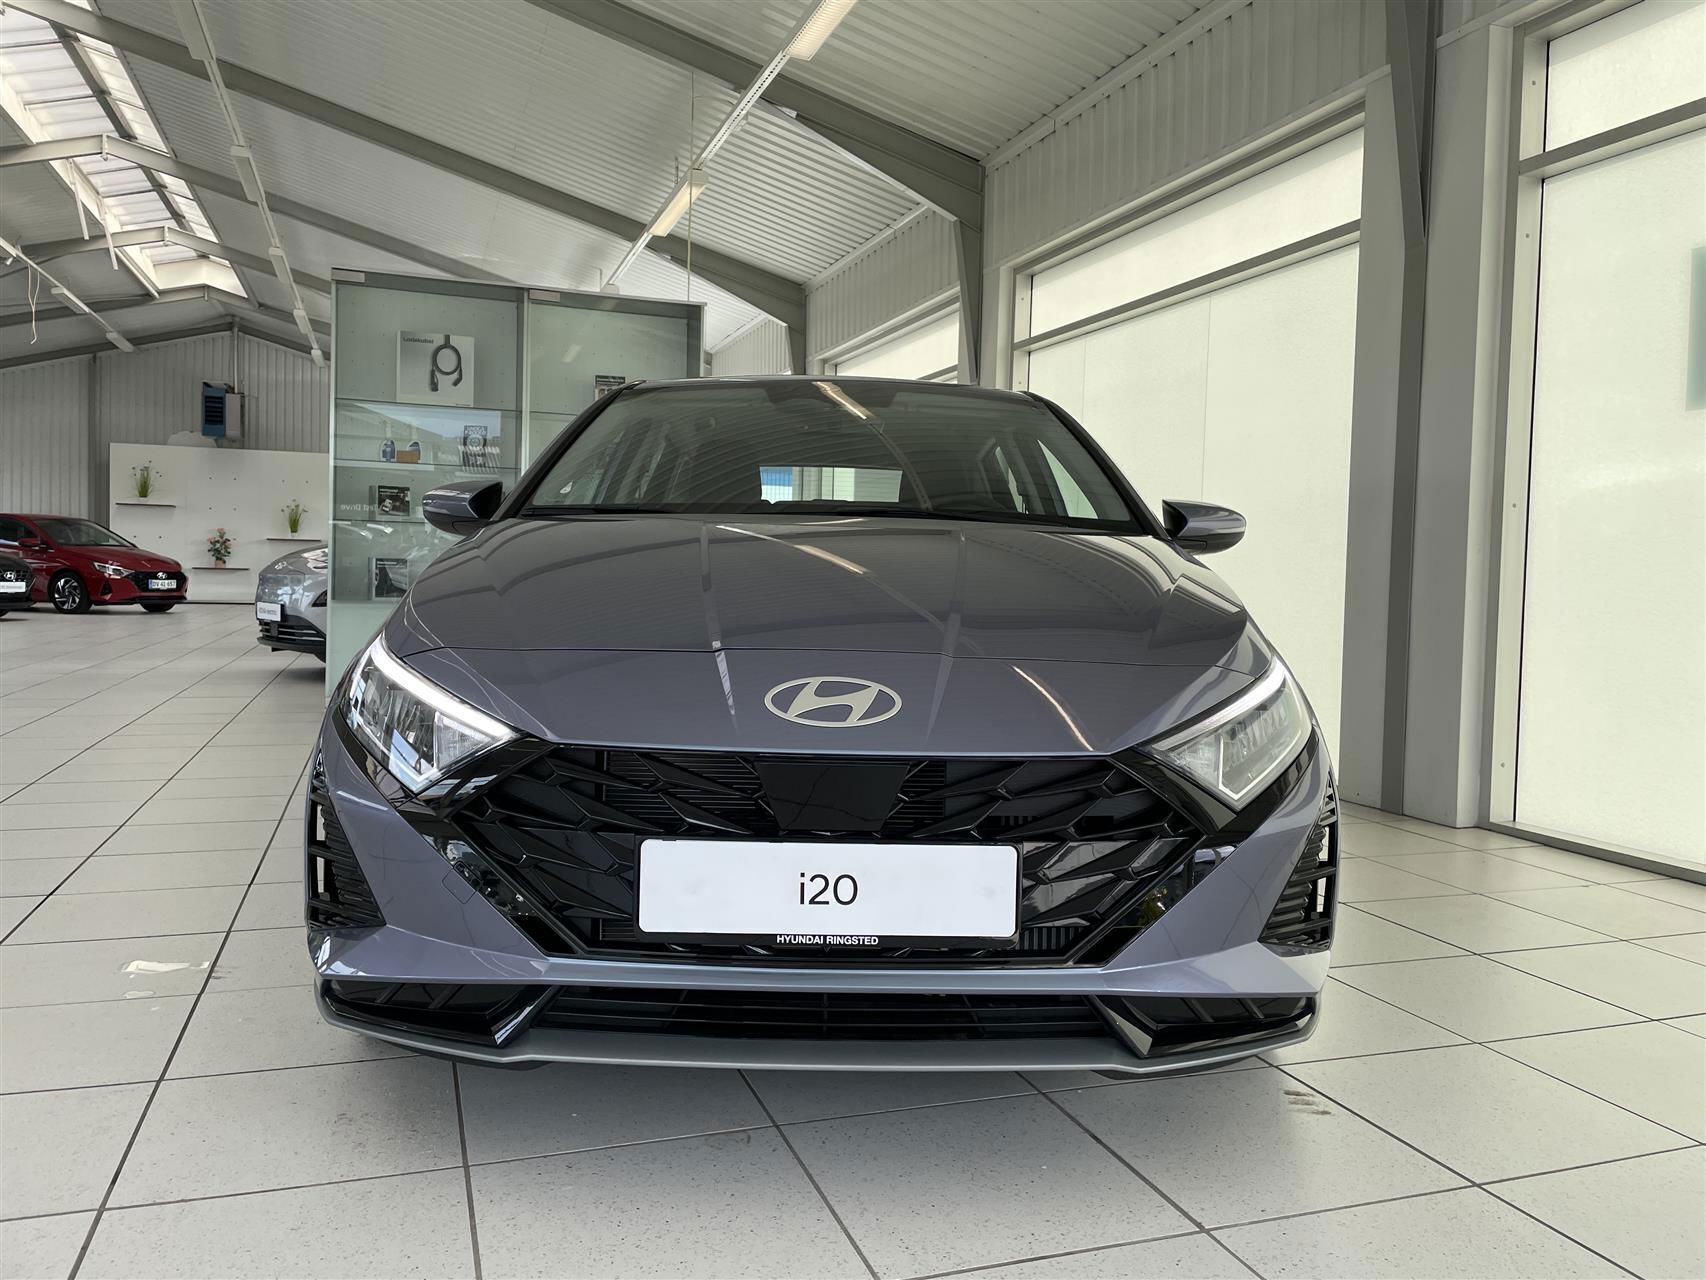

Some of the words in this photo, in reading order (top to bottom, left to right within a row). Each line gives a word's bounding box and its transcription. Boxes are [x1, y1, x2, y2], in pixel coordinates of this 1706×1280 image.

[800, 872, 858, 906] i20
[776, 934, 824, 945] HYUNDAI
[826, 935, 879, 946] RINGSTED
